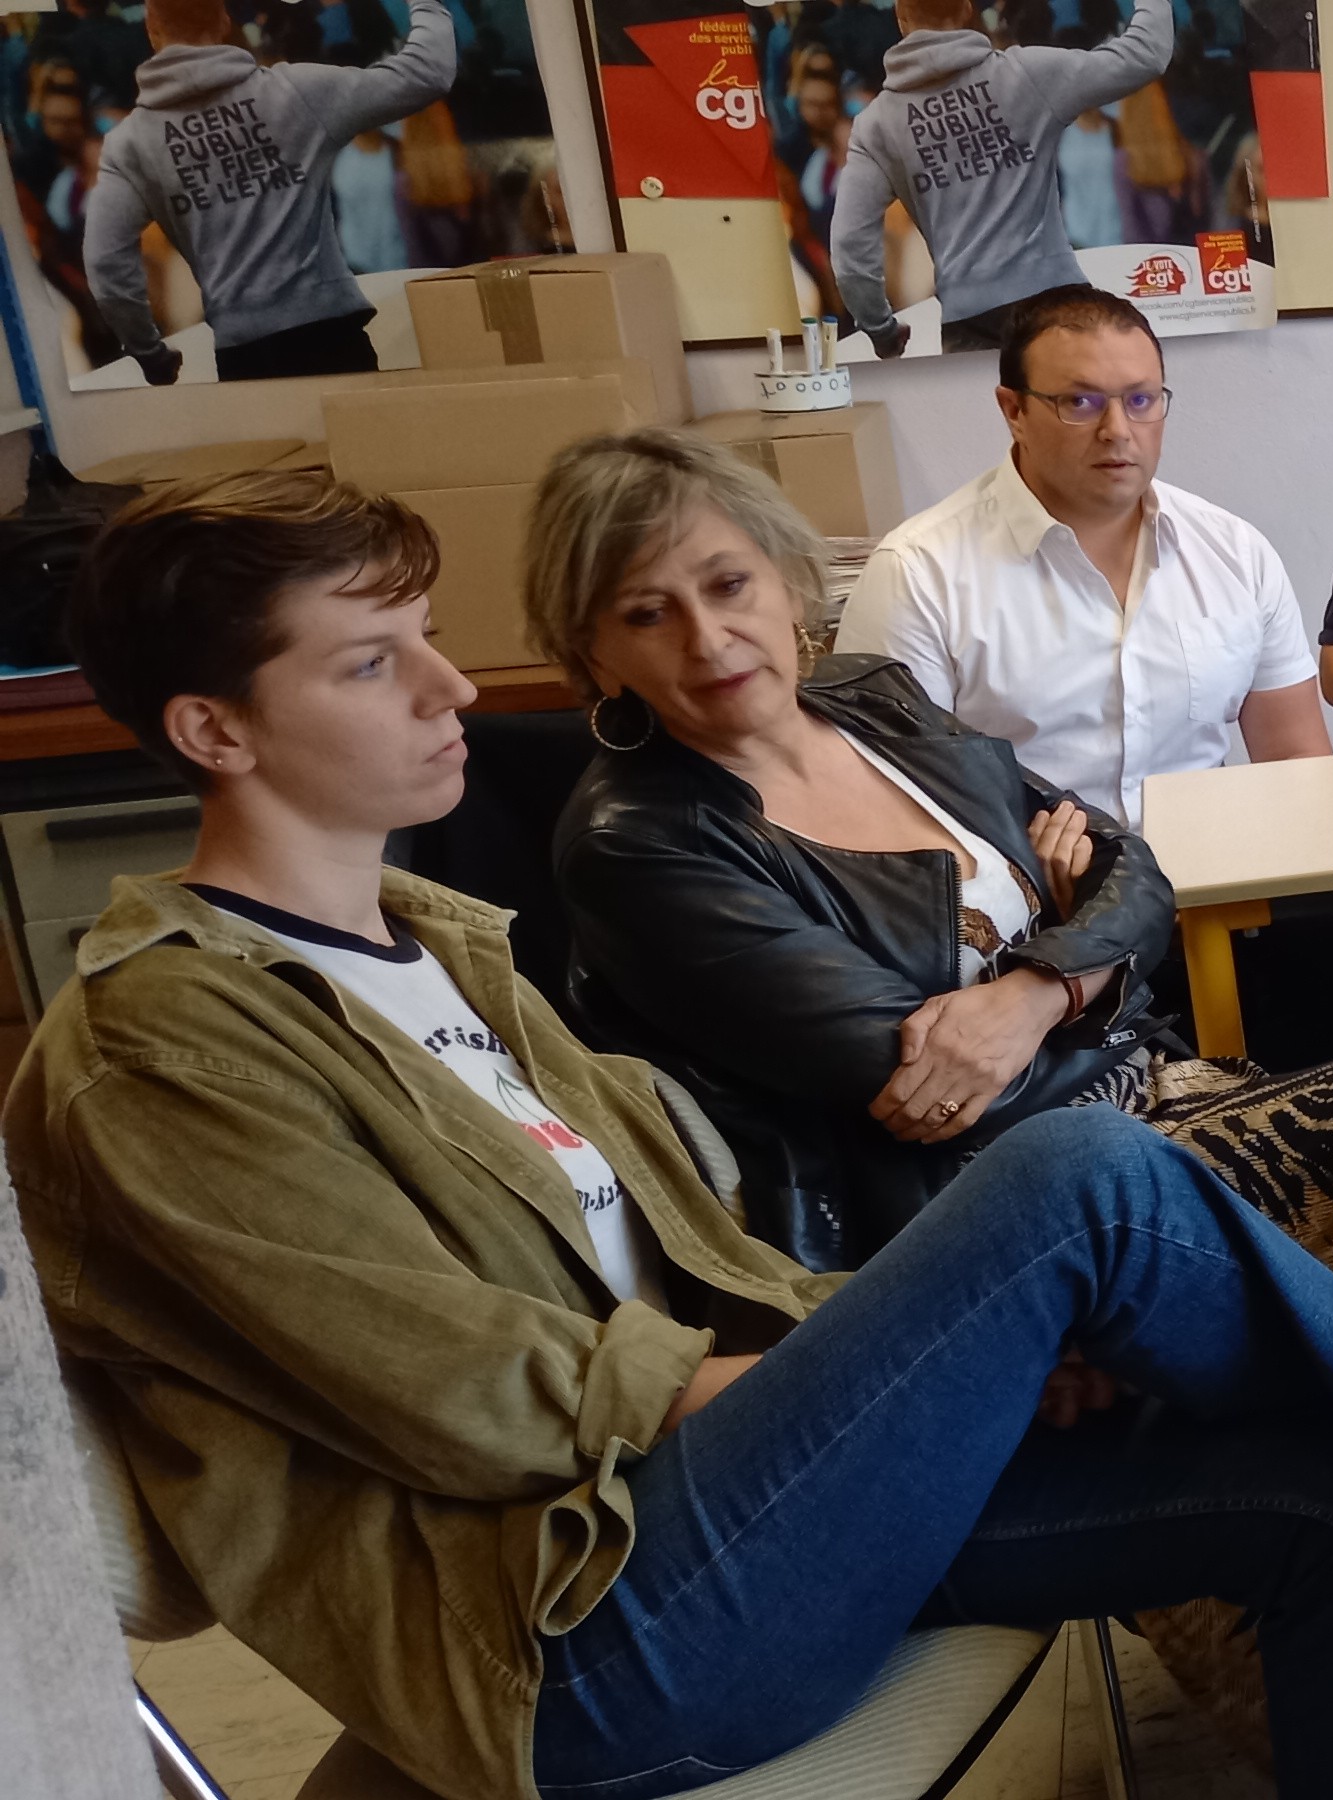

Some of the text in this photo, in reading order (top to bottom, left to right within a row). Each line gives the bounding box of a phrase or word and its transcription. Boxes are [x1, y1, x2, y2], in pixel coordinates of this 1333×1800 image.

[689, 33, 712, 43] des
[699, 58, 757, 88] la
[907, 80, 992, 126] AGENT
[164, 98, 259, 145] AGENT
[910, 104, 1004, 146] PUBLIC
[169, 122, 272, 166] PUBLIC
[917, 125, 1015, 169] ET FIER
[176, 145, 284, 190] ET FIER
[912, 166, 951, 194] DE
[170, 188, 212, 216] DE
[1145, 268, 1176, 288] cgt
[1208, 264, 1251, 293] cgt
